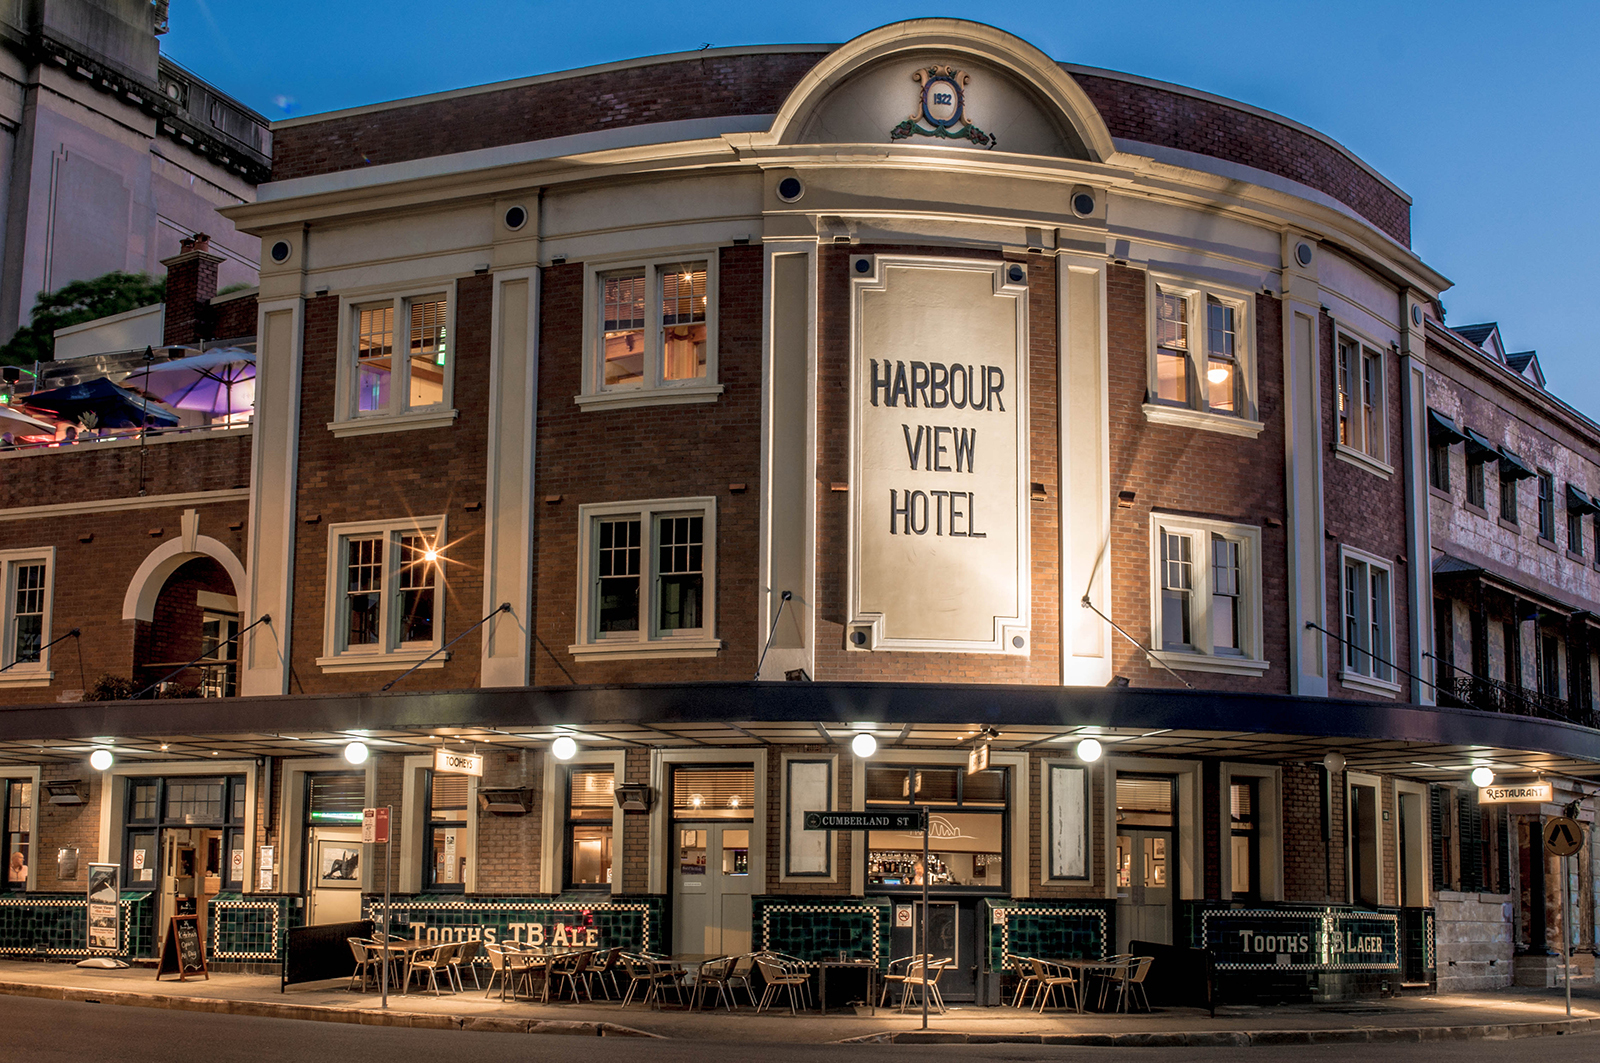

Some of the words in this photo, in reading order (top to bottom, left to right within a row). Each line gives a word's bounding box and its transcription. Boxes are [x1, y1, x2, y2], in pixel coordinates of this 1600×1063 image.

[933, 93, 952, 106] 1922
[869, 358, 1006, 412] HARBOUR
[901, 423, 977, 473] VIEW
[889, 489, 987, 538] HOTEL
[445, 756, 473, 769] TOOHEYS
[1485, 788, 1543, 800] RESTAURANT
[821, 816, 890, 826] CUMBERLAND
[896, 816, 910, 826] ST
[551, 922, 599, 947] ALE
[1239, 929, 1309, 953] TOOTH'S
[1347, 930, 1383, 953] LAGER
